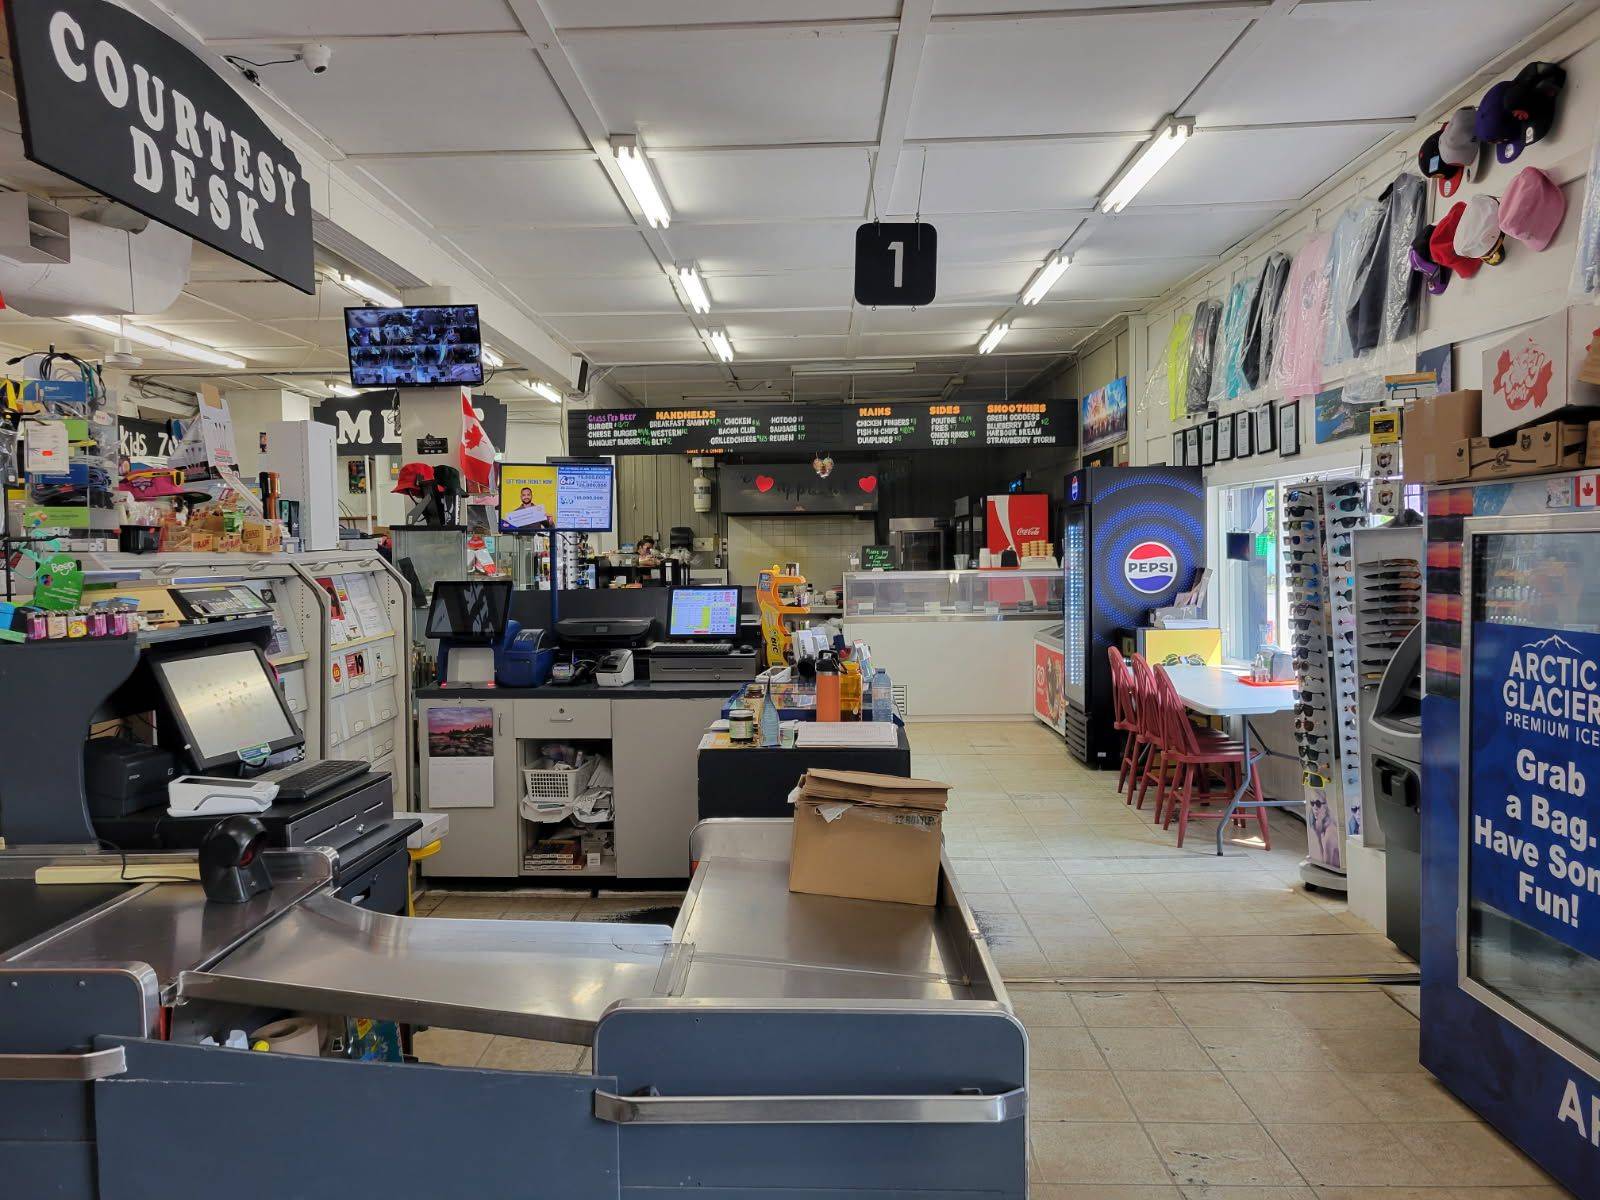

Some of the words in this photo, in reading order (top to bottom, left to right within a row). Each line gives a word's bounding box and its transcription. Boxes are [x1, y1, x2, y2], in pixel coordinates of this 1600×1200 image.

[50, 12, 295, 216] COURTESY
[130, 126, 264, 250] DESK
[888, 242, 904, 287] 1
[860, 408, 892, 416] MAINS
[929, 405, 960, 414] SIDES
[987, 404, 1046, 413] SMOOTHIES
[656, 410, 716, 420] HANDHELDS
[986, 414, 1008, 422] GREEN
[650, 420, 684, 428] BREAKFAST
[724, 417, 752, 425] CHICKEN
[884, 418, 910, 426] FINGERS
[740, 426, 756, 434] CLUB
[770, 425, 797, 433] SAUSAGE
[932, 424, 949, 432] FRIES
[986, 422, 1021, 430] BLUEBERRY
[588, 430, 612, 438] CHEESE
[857, 428, 898, 436] FISH-N-CHIPS
[120, 425, 147, 457] Kids
[618, 438, 640, 446] BURGER
[770, 434, 794, 442] REUBEN
[858, 436, 894, 444] DUMPLINGS
[986, 436, 1031, 444] STRAWBERRY
[1033, 436, 1056, 444] STORM
[51, 561, 75, 574] Beep
[1128, 562, 1174, 572] PEPSI
[1508, 650, 1598, 691] ARCTIC
[1503, 680, 1600, 726] GLACIER
[1505, 711, 1568, 740] PREMIUM
[1576, 727, 1600, 747] ICE
[1516, 749, 1586, 797] Grab
[1506, 794, 1522, 820] a
[1532, 794, 1596, 852] Bag.
[1474, 815, 1539, 868] Have
[1519, 871, 1578, 928] Fun!
